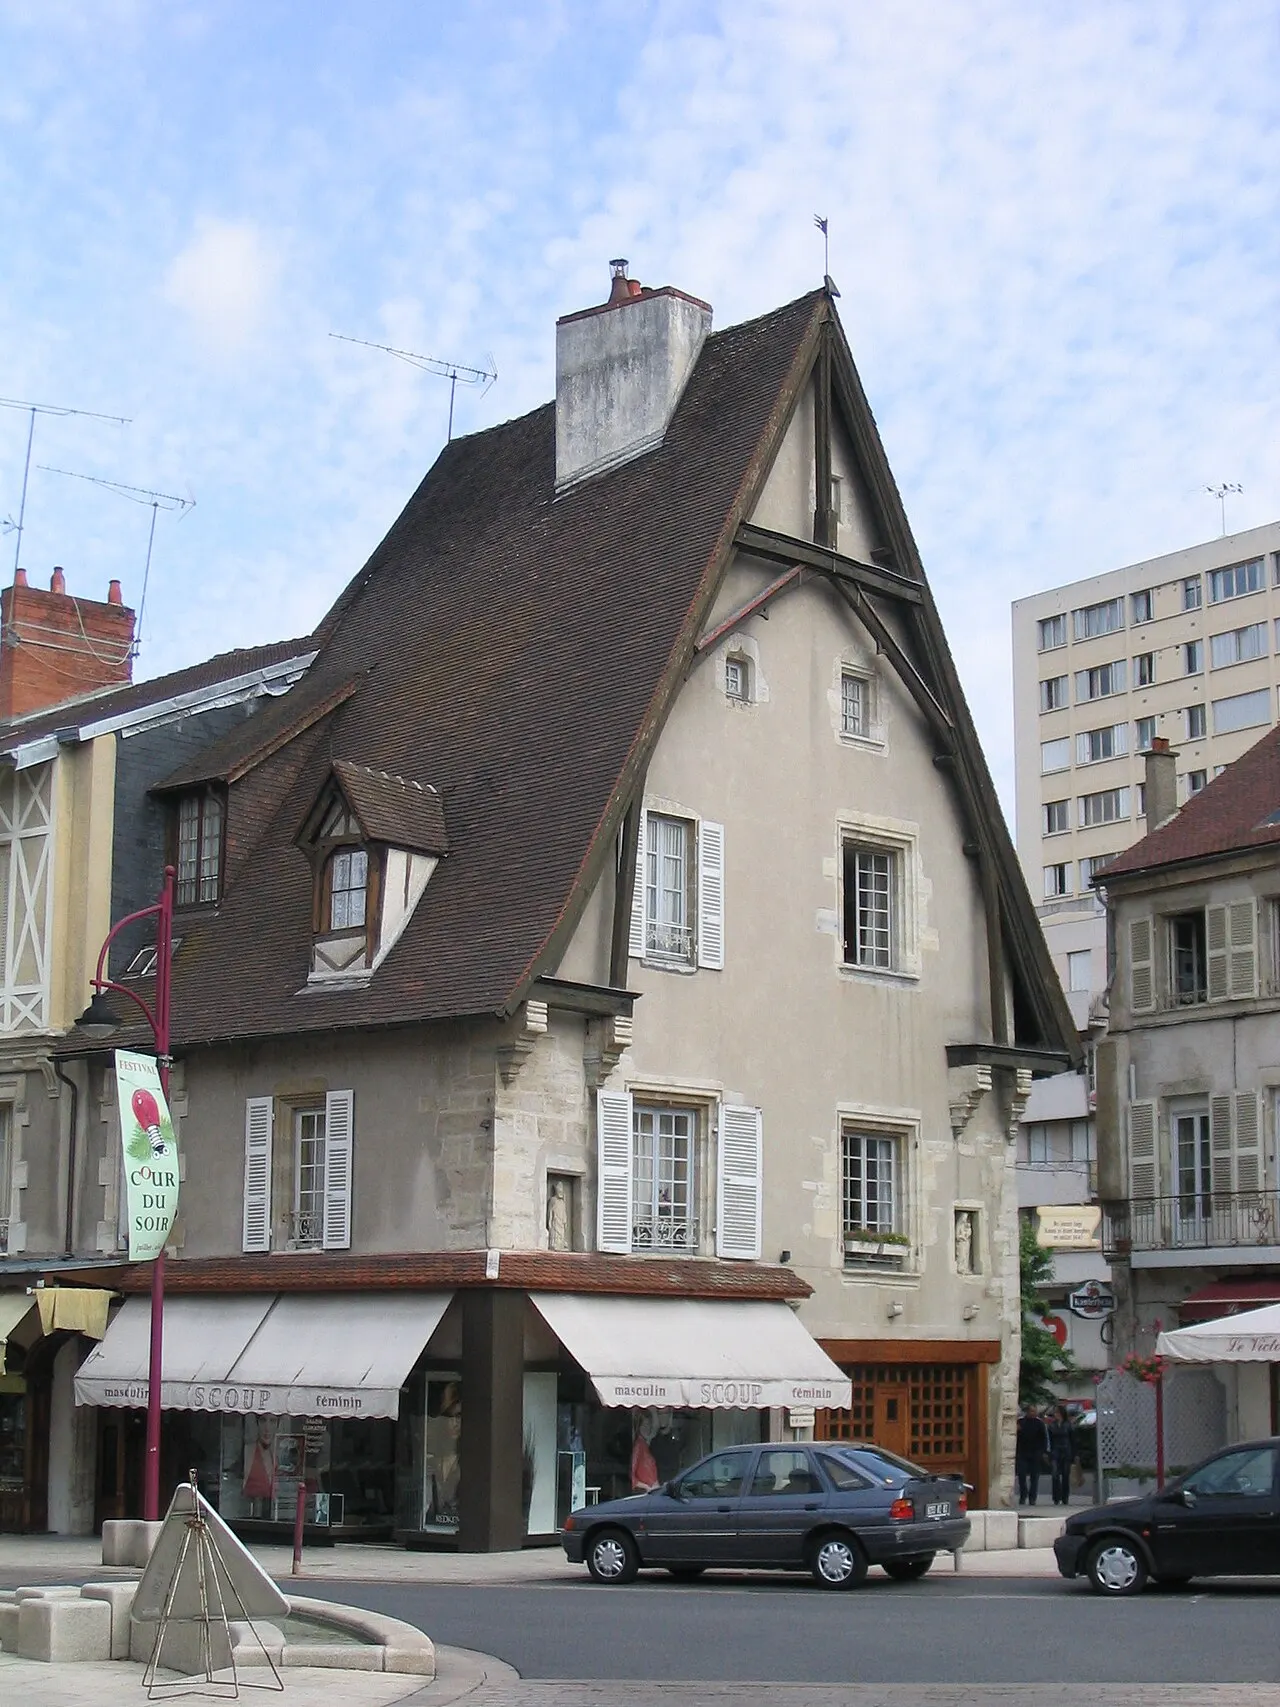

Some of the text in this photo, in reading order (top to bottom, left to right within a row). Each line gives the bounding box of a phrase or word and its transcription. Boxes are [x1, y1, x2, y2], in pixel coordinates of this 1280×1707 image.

[119, 1060, 157, 1075] FESTIVAL
[131, 1166, 175, 1187] COUR
[142, 1194, 166, 1209] DU
[135, 1216, 169, 1231] SOIR
[1226, 1337, 1245, 1352] Le
[194, 1387, 271, 1410] SCOUP
[316, 1395, 362, 1409] féminin
[614, 1383, 832, 1404] masculin SCOUP féminin
